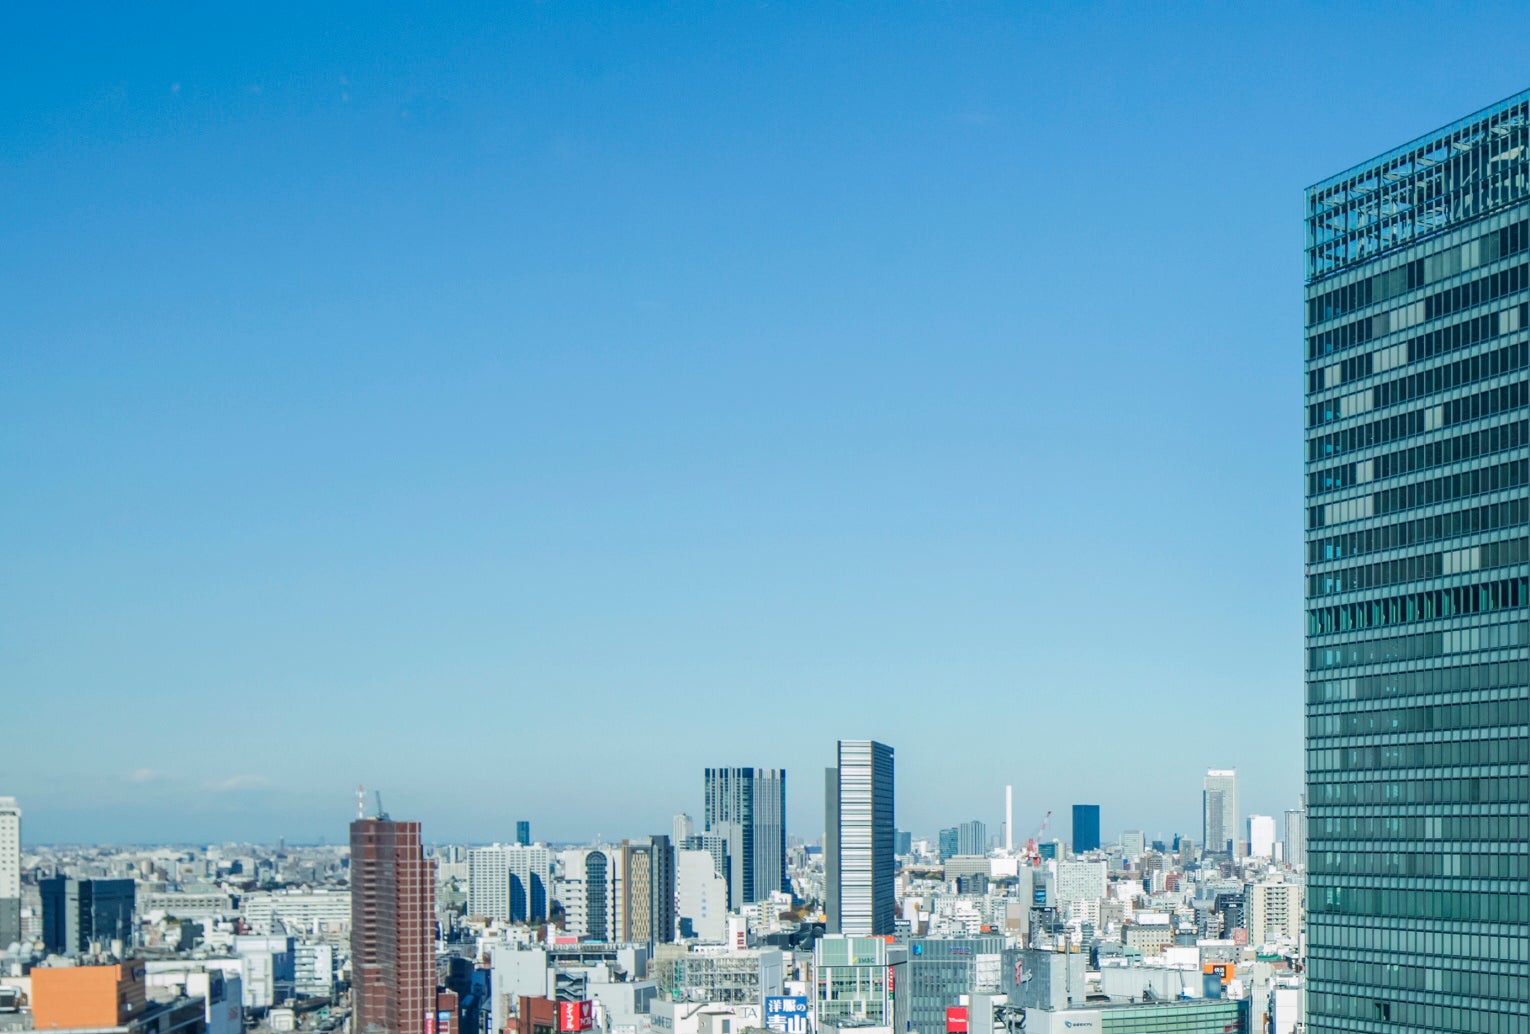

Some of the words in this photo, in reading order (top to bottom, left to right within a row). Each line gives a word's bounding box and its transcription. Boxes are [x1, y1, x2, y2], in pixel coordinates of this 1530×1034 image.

[566, 1002, 574, 1029] アイフル
[768, 999, 806, 1013] 洋服の
[766, 1014, 807, 1034] 青山
